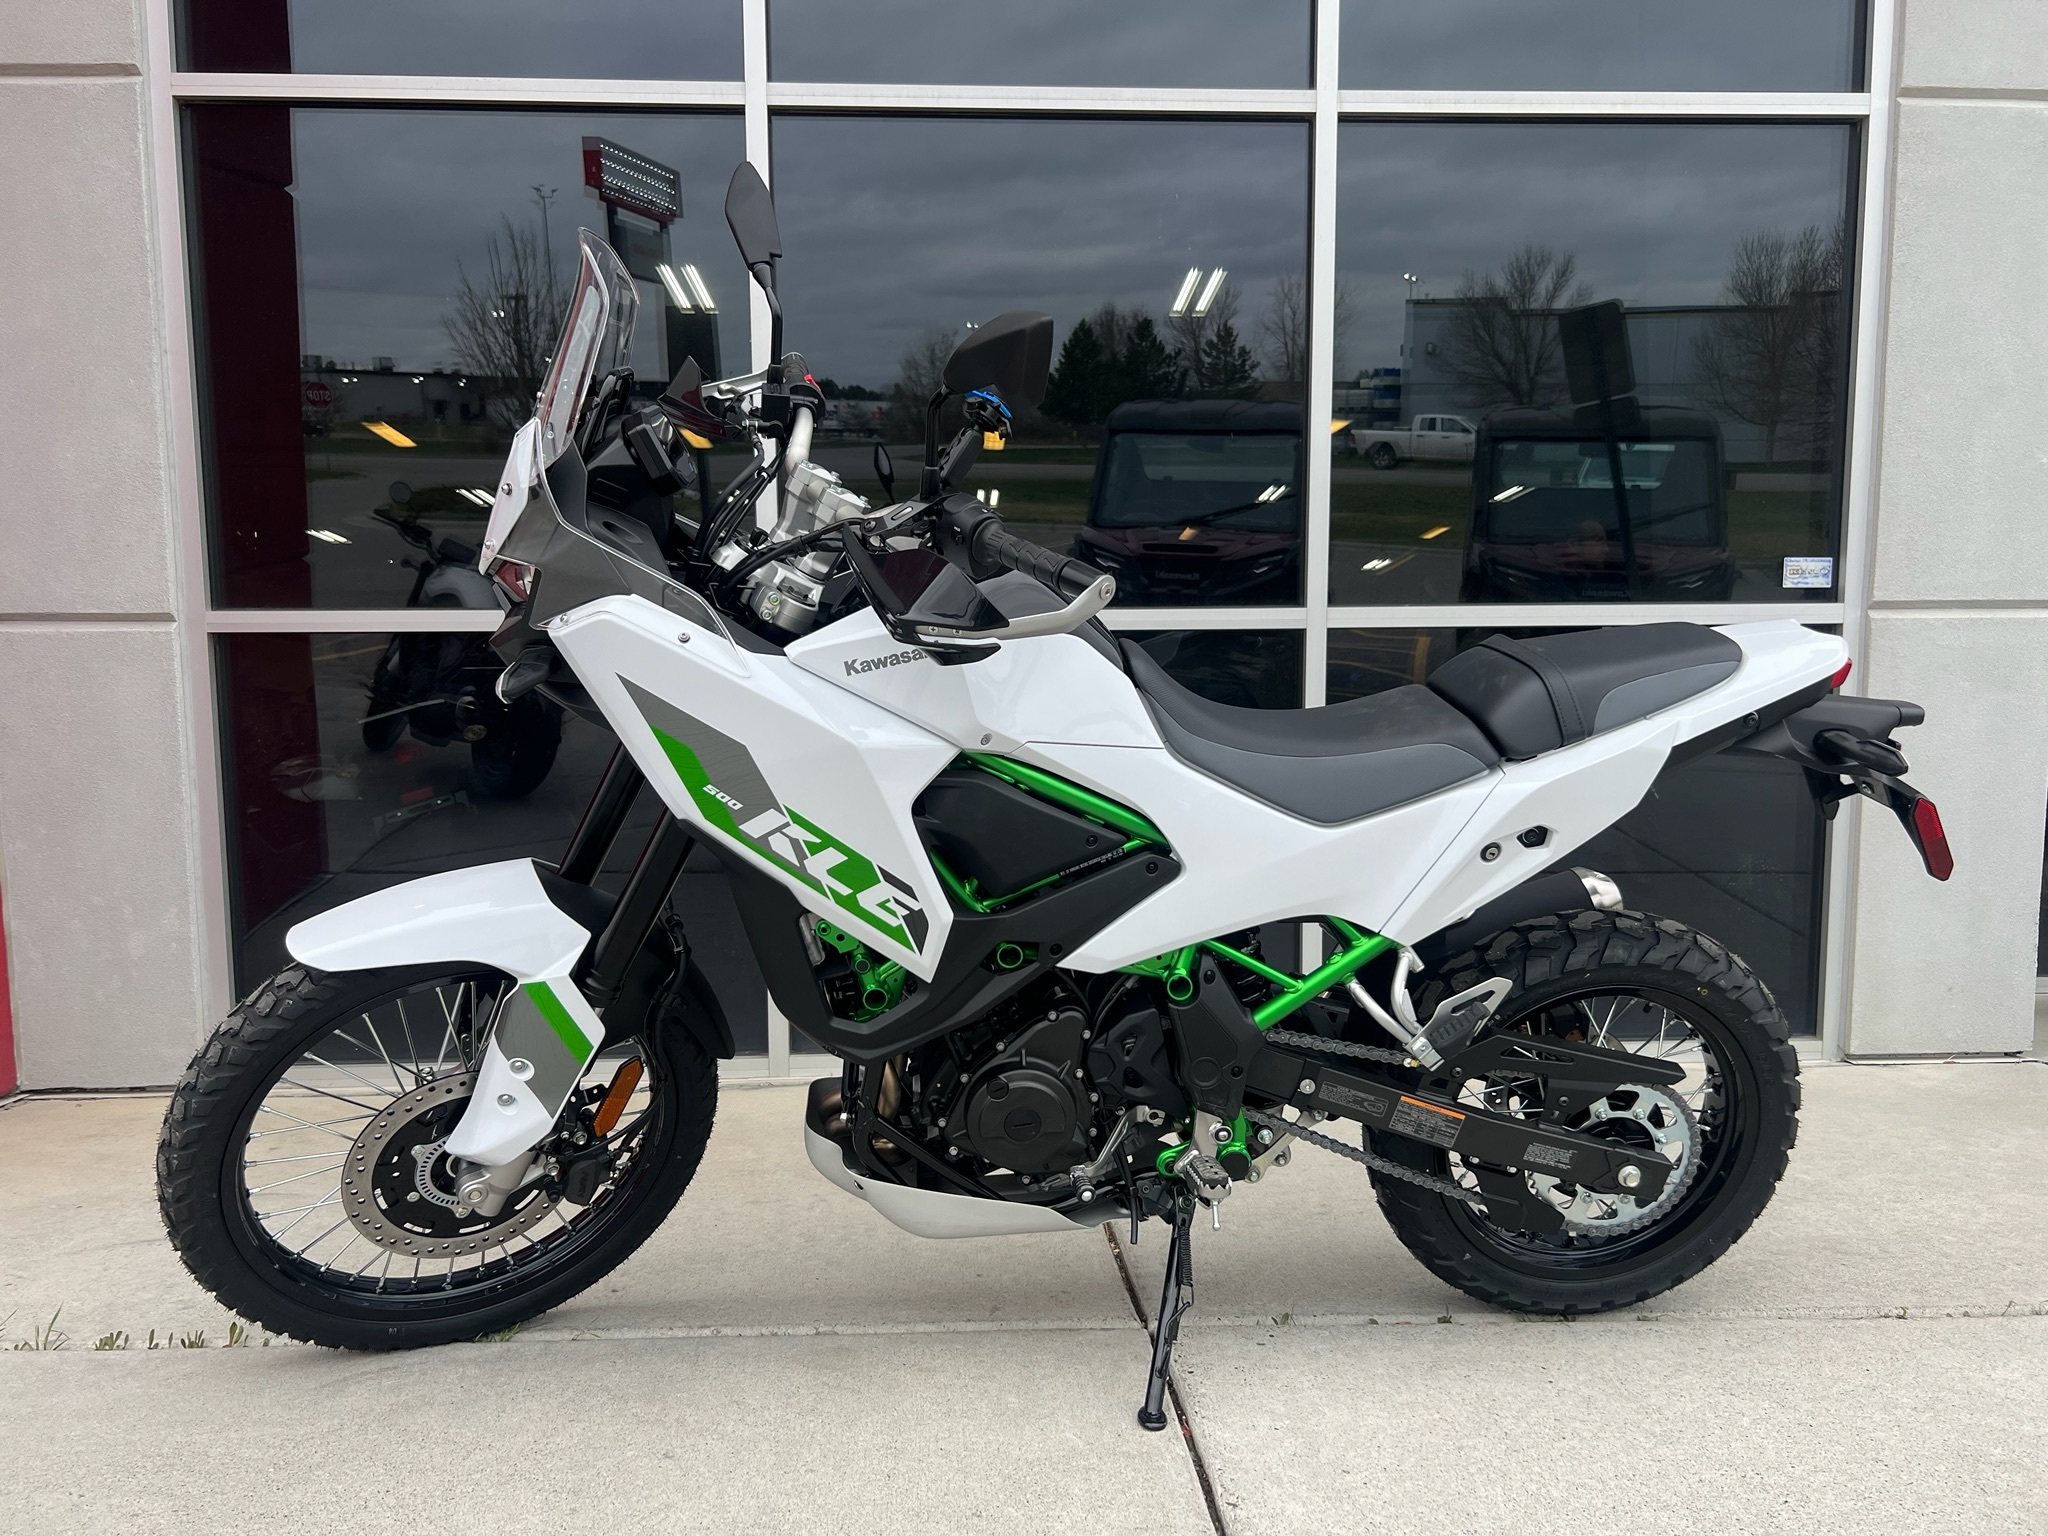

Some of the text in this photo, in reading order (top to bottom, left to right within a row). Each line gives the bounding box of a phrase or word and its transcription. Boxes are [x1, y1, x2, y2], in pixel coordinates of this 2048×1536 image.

[843, 648, 927, 677] Kawasa
[702, 784, 744, 811] 500
[738, 808, 922, 928] KLE
